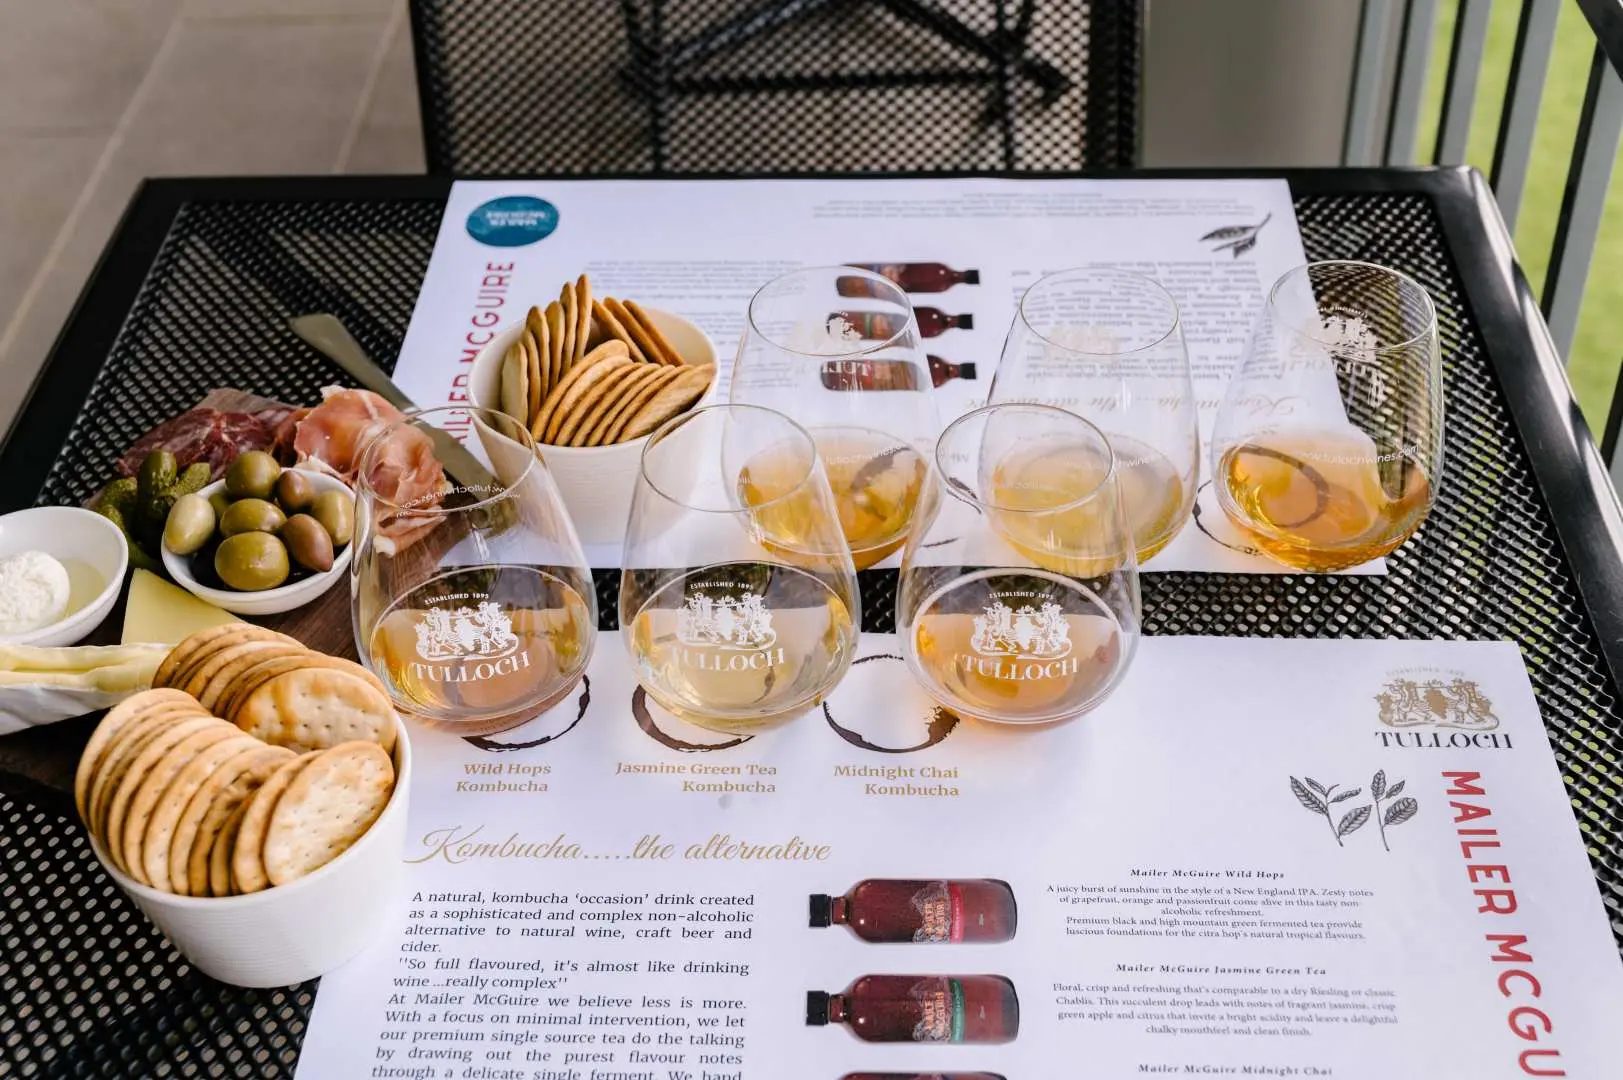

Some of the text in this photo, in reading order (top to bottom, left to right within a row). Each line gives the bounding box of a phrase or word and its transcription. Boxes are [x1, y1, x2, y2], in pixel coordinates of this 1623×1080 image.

[459, 262, 515, 363] MCGUIRE
[690, 581, 734, 590] ESTABLISHED
[424, 593, 469, 605] ESTABLISHED
[989, 591, 1035, 599] ESTABLISHED
[411, 650, 531, 682] TULLOCH
[668, 647, 785, 672] TULLOCH
[962, 653, 1079, 681] TULLOCH
[1374, 731, 1514, 749] TULLOCH
[463, 763, 552, 777] Wild Hops
[615, 762, 778, 776] Jasmine Green Tea
[834, 765, 959, 780] Midnight Chai
[456, 780, 548, 792] Kombucha
[682, 780, 777, 793] Kombucha
[865, 783, 960, 796] Kombucha
[684, 833, 832, 861] alternative
[1130, 869, 1283, 879] Mailer McGuire Wild Hops
[412, 891, 423, 902] A
[428, 892, 485, 904] natural,
[491, 892, 568, 903] kombucha
[654, 893, 694, 904] drink
[699, 894, 753, 905] created
[408, 910, 424, 918] as
[429, 910, 438, 918] a
[443, 908, 541, 921] sophisticated
[546, 909, 574, 920] and
[579, 909, 642, 922] complex
[1441, 771, 1566, 1078] MAILER MCGU
[404, 925, 751, 939] alternative to natural wine, craft beer and
[400, 941, 440, 952] cider.
[434, 958, 460, 969] full
[468, 959, 543, 972] flavoured,
[554, 959, 578, 971] it's
[586, 960, 638, 972] almost
[647, 960, 675, 972] like
[683, 961, 749, 976] drinking
[1116, 964, 1325, 975] Mailer McGuire Jasmine Green Tea
[393, 976, 429, 987] wine
[387, 993, 745, 1008] At Mailer McGuire we believe less is more.
[385, 1010, 744, 1027] With a focus on minimal intervention, we let
[379, 1030, 744, 1048] our premium single source tea do the talking
[375, 1046, 742, 1064] by drawing out the purest flavour notes
[371, 1065, 741, 1080] through a delicate single ferment. We hand
[1138, 1064, 1332, 1076] Mailer McGuire Midnight Chai
